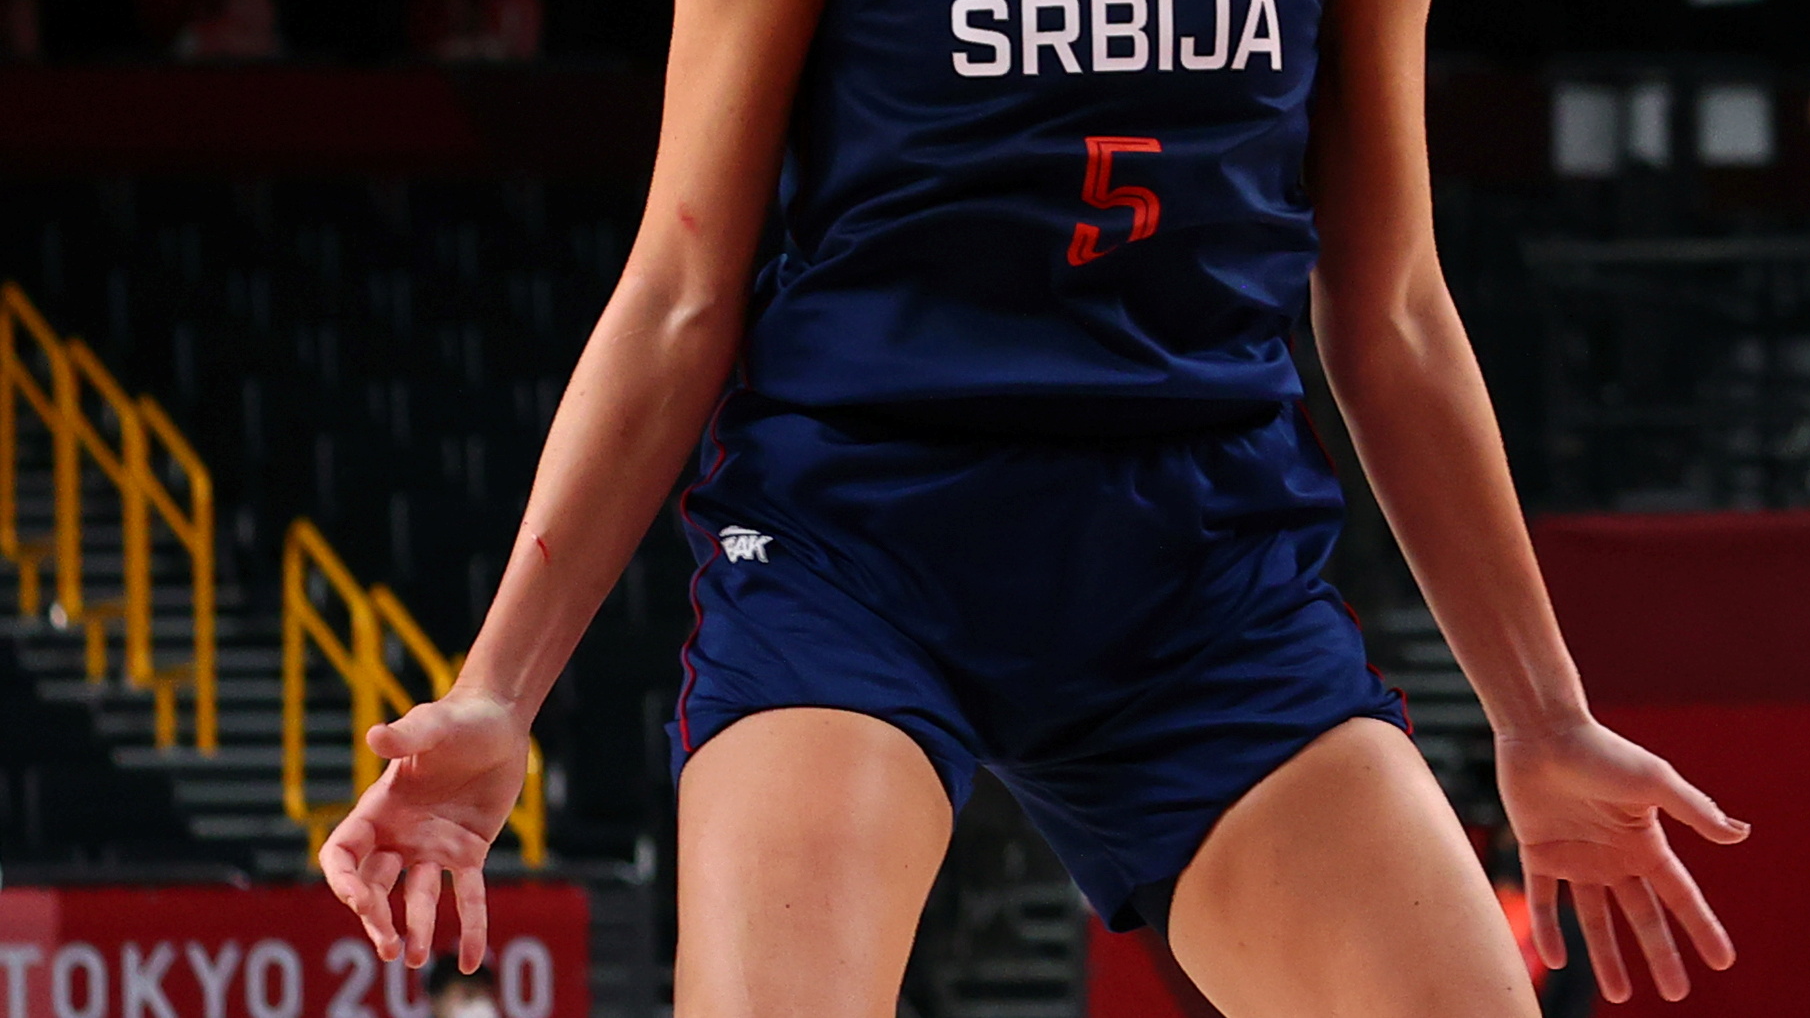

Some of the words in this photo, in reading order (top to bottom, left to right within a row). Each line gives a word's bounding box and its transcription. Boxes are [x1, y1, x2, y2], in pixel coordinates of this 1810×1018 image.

[1066, 136, 1163, 267] 5
[719, 535, 774, 563] EAK
[0, 939, 303, 1018] TOKYO
[325, 939, 553, 1018] 200
